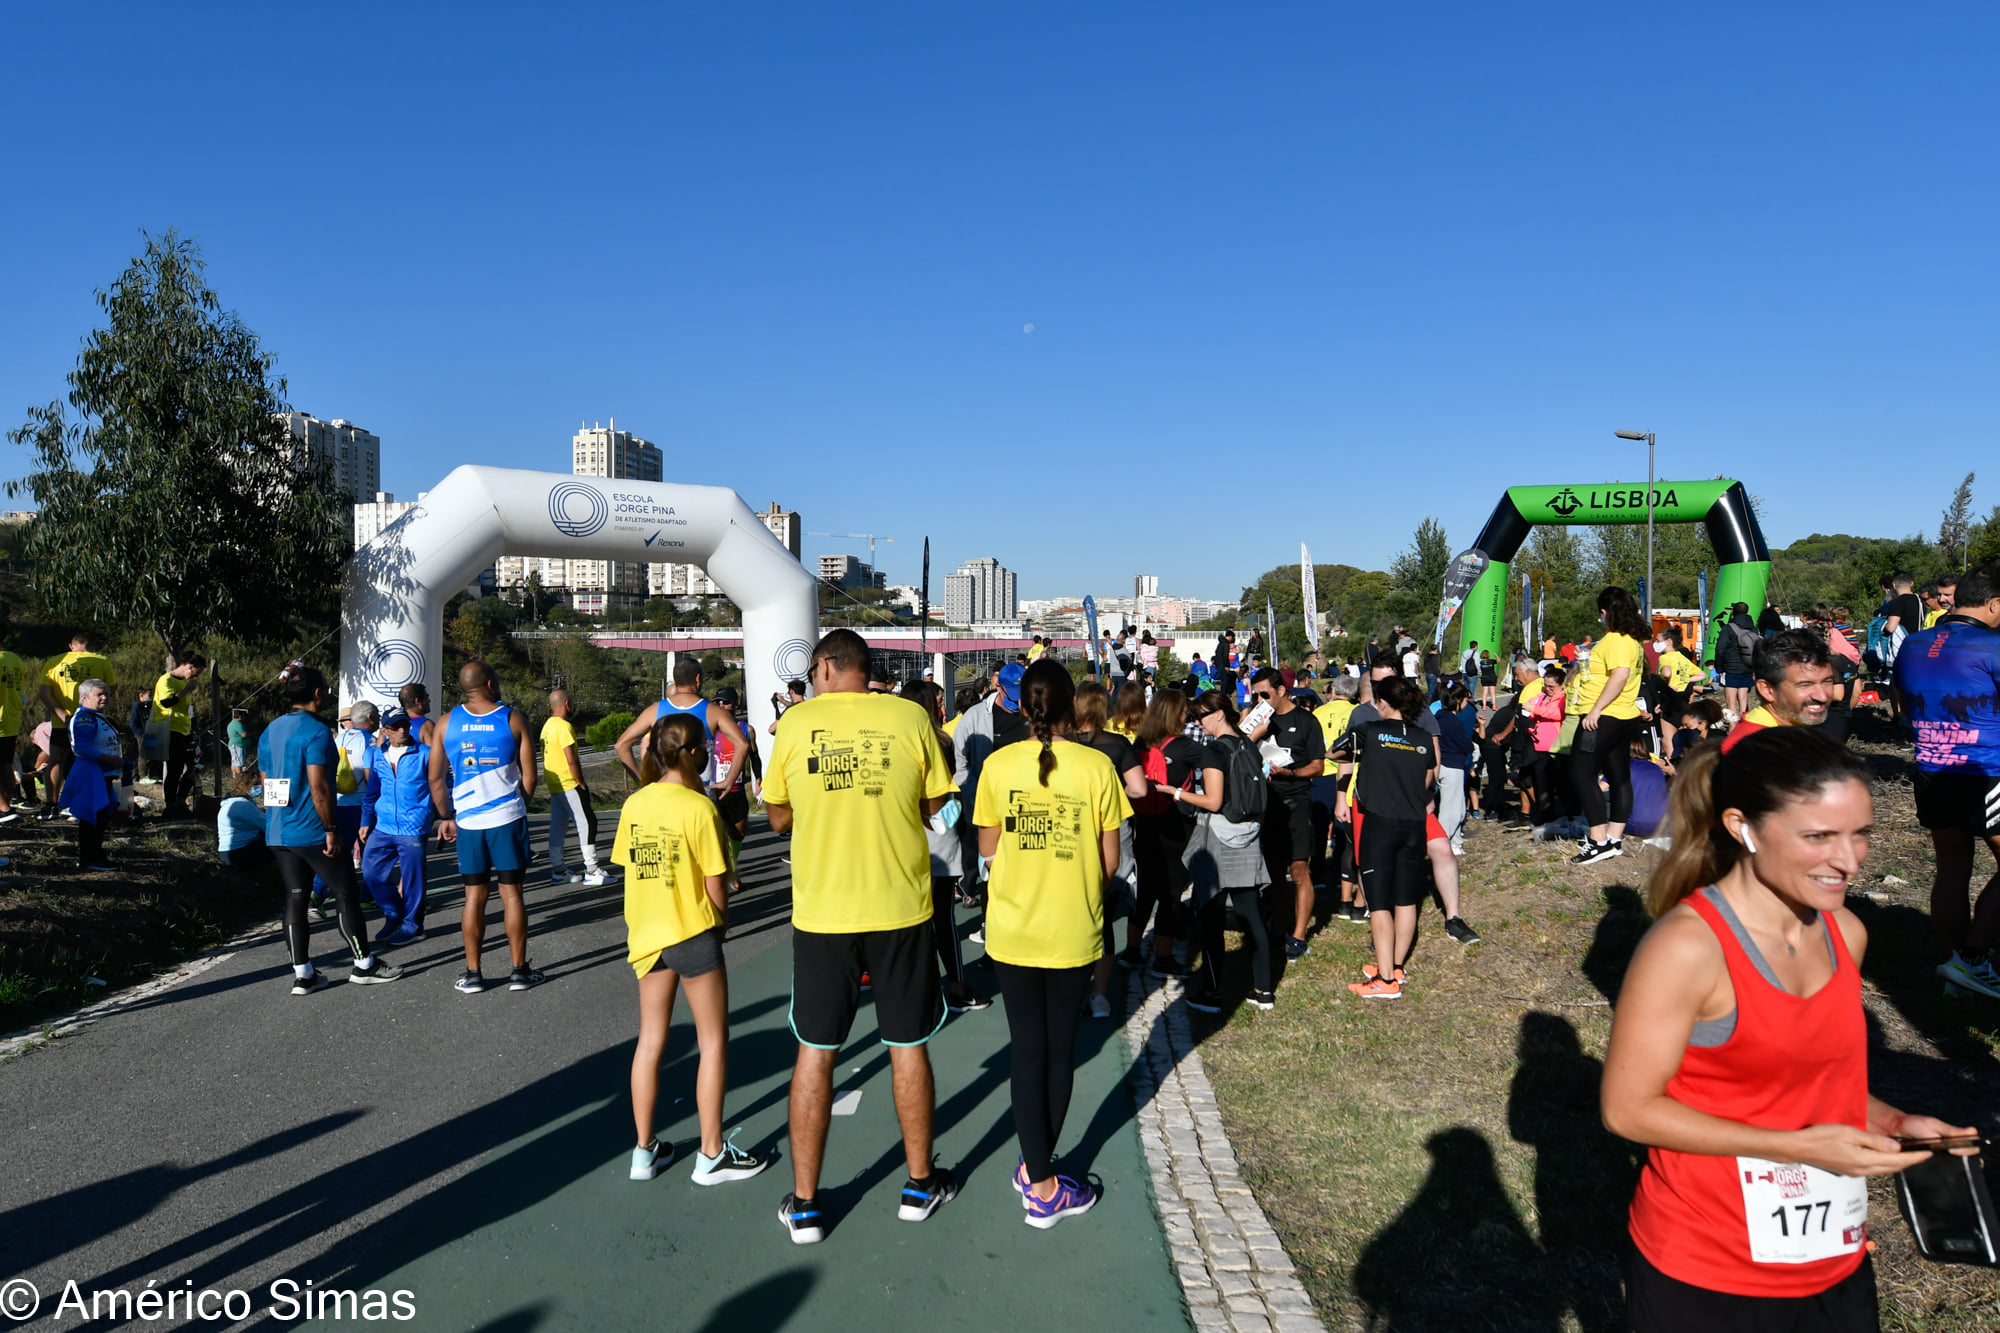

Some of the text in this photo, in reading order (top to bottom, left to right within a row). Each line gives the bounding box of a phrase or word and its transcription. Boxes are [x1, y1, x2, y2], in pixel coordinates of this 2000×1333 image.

[613, 493, 655, 503] ESCOLA
[1590, 489, 1679, 509] LISBOA
[614, 503, 676, 515] JORGE PINA
[624, 516, 656, 524] ATLETISMO
[656, 518, 688, 526] ADAPTADO
[657, 538, 685, 548] Rexona
[1489, 584, 1500, 643] www.cm-lisboa.pt
[461, 723, 495, 732] ZÉ SANTOS
[1245, 713, 1264, 733] 1113
[1941, 721, 1961, 730] TO
[1918, 729, 1980, 744] SWIM
[816, 754, 859, 773] JORGE
[824, 772, 853, 791] PINA
[1013, 816, 1052, 833] JORGE
[1020, 834, 1046, 849] PINA
[637, 863, 660, 879] PINA
[1781, 1184, 1806, 1199] PINA
[1771, 1200, 1832, 1237] 177
